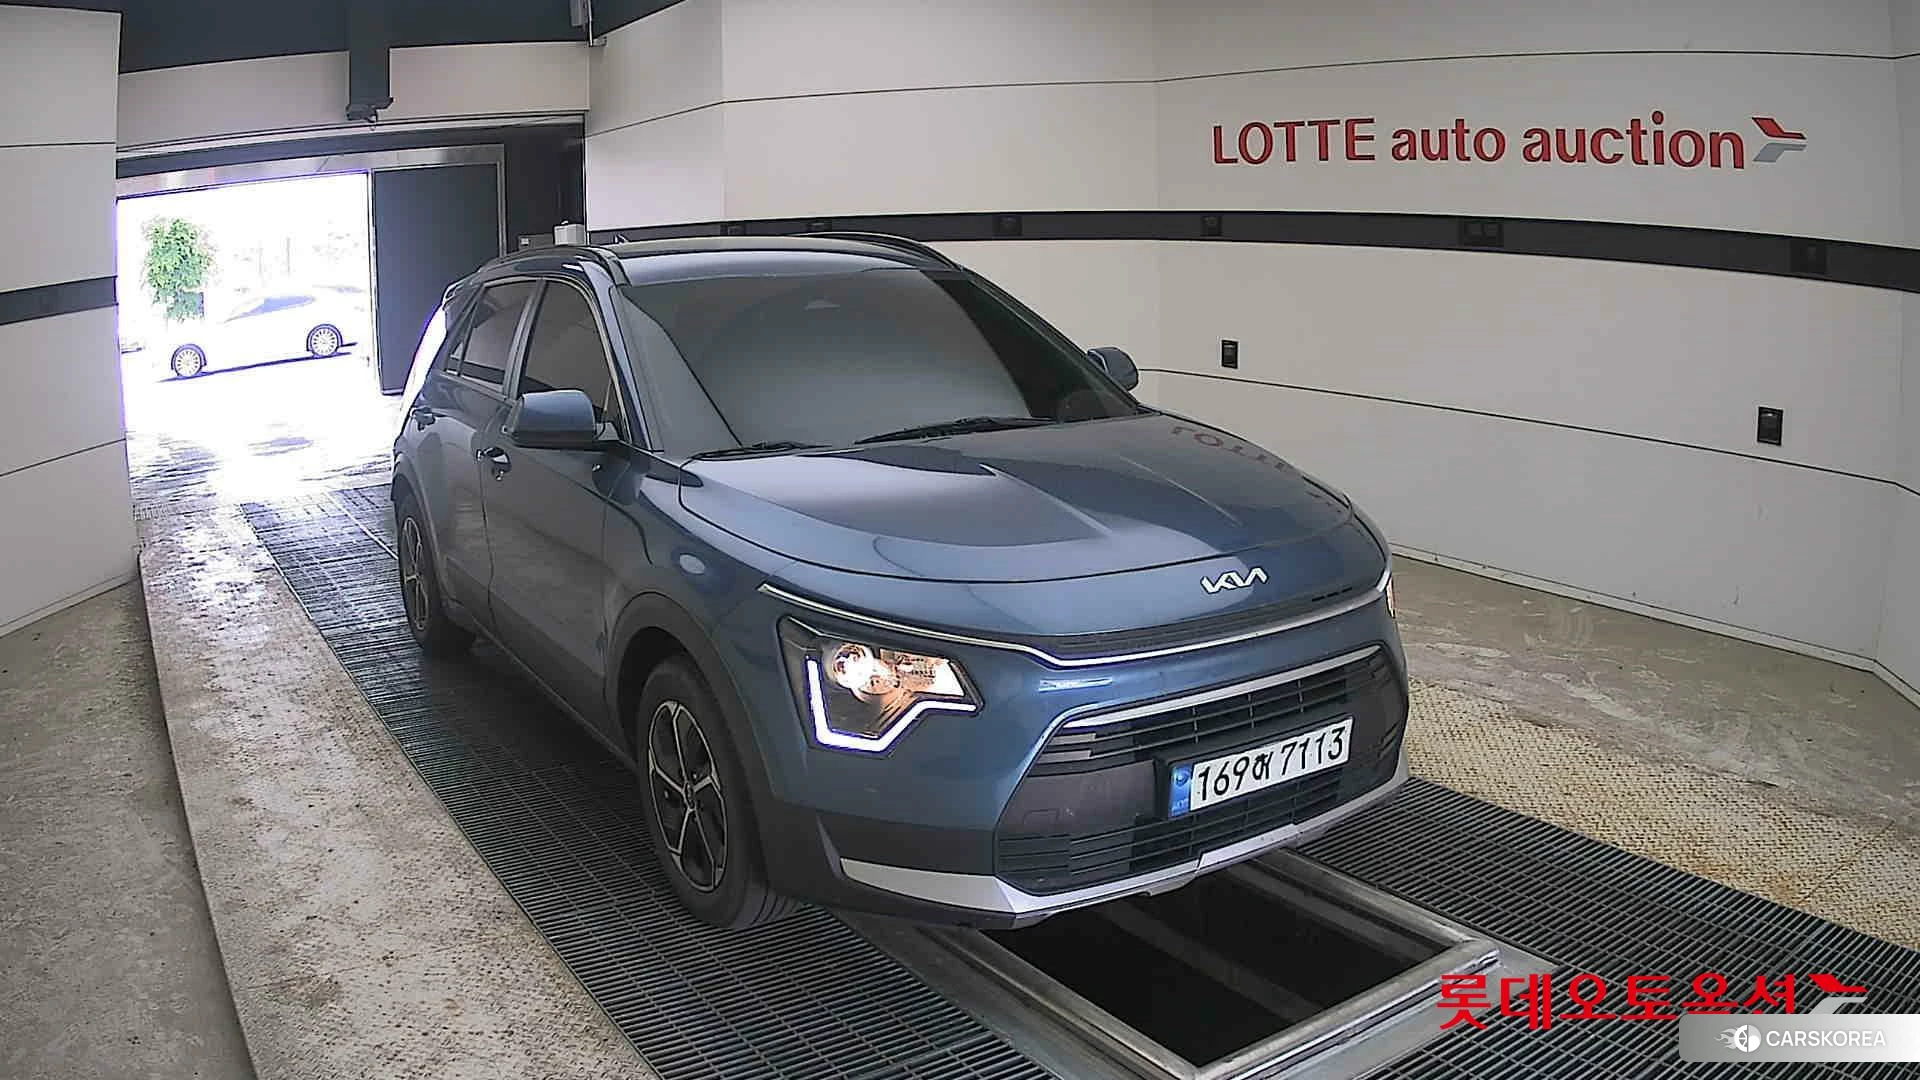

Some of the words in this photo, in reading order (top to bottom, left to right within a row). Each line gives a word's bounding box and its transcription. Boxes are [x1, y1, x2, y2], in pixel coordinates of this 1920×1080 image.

[1213, 118, 1375, 164] LOTTE
[1391, 118, 1507, 162] auto
[1522, 110, 1745, 170] auction
[1201, 566, 1268, 594] KIA
[1280, 725, 1346, 776] 7113
